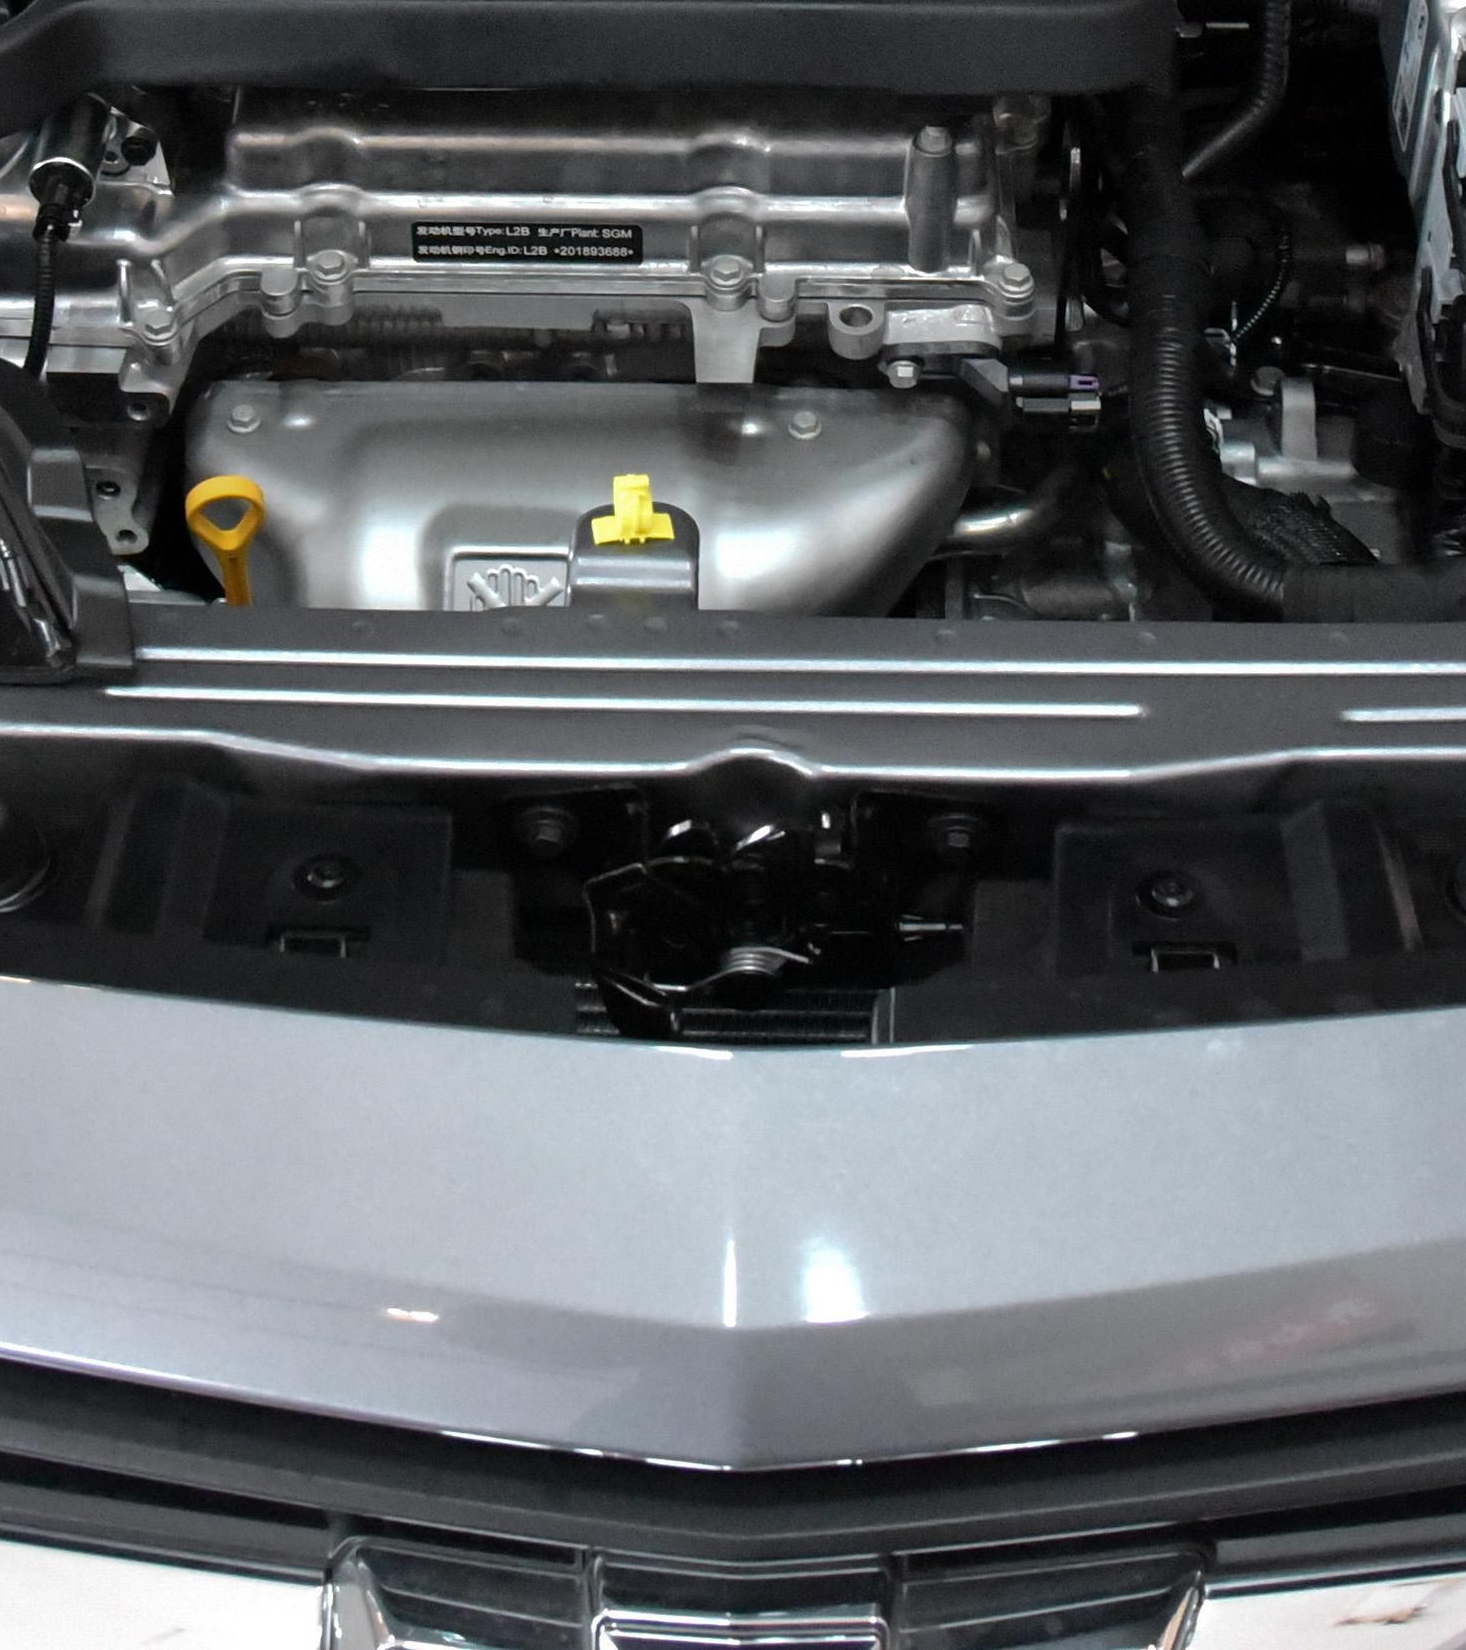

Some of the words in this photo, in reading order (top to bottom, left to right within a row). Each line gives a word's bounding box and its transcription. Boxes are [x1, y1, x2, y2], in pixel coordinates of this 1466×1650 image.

[505, 226, 531, 237] L2B
[601, 228, 633, 239] SGM
[523, 245, 548, 256] L2B
